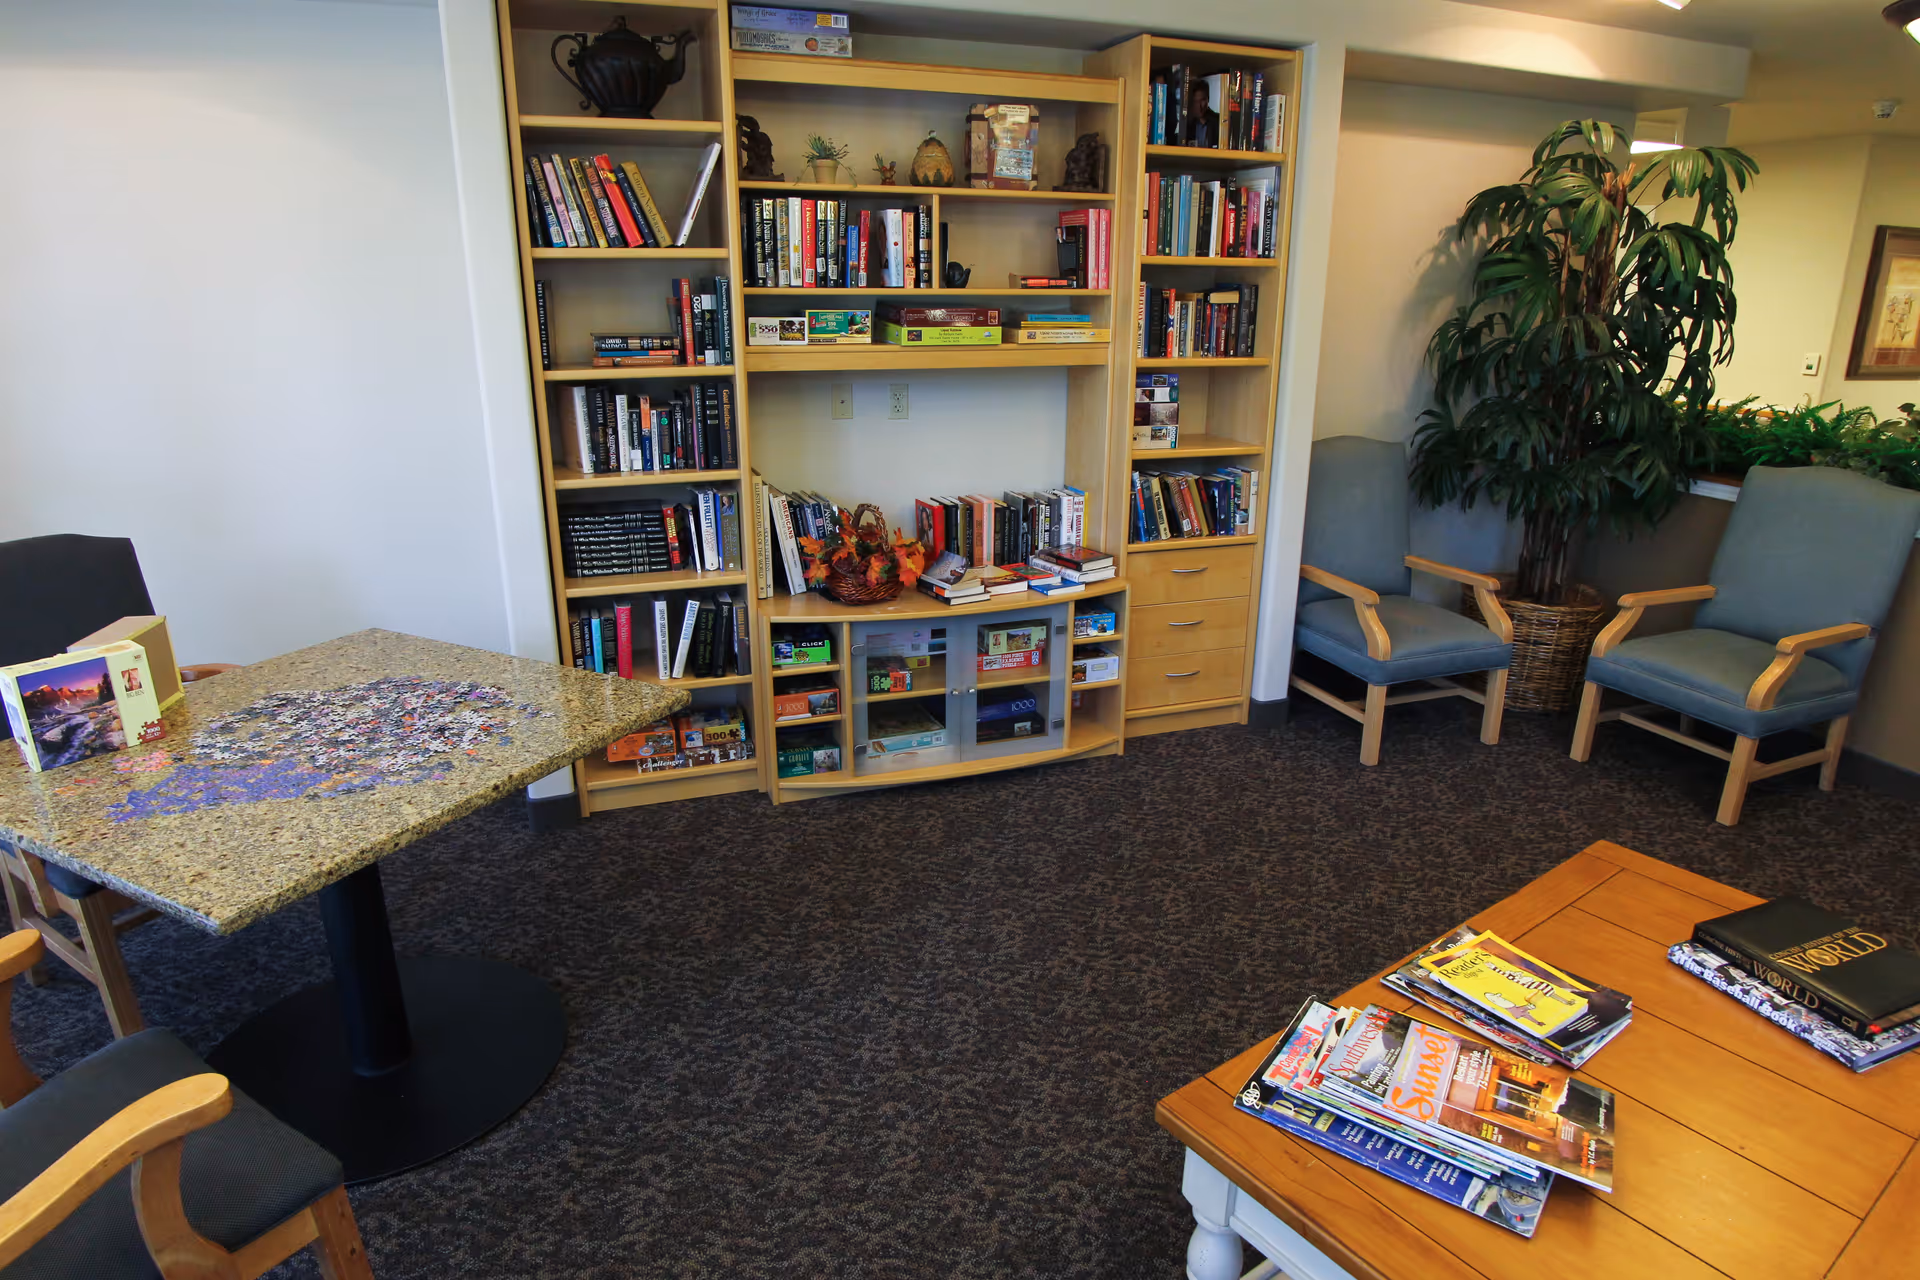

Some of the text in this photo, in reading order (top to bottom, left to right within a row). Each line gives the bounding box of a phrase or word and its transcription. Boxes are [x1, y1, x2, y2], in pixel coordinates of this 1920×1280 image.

[631, 169, 646, 198] Citizen
[1266, 207, 1272, 218] MY
[721, 282, 729, 310] Discovering
[722, 389, 731, 430] Goat Brothers
[754, 482, 762, 520] ILLUSTRATED
[704, 505, 713, 528] FOLLETT
[780, 499, 795, 540] AMERICANS
[685, 602, 697, 622] SANDRA
[126, 689, 145, 699] BIG BEN
[1011, 699, 1036, 711] 1000
[705, 731, 727, 742] 300
[642, 759, 684, 769] Challenger
[1768, 926, 1862, 961] CONCISE HISTORY OF THE
[1777, 932, 1888, 974] WORLD
[1439, 950, 1493, 980] Reader's
[1463, 969, 1485, 980] digest
[1677, 950, 1800, 1033] The Baseball Book
[1752, 960, 1820, 1009] WORLD
[1361, 1062, 1391, 1089] Painting
[1390, 1023, 1452, 1121] Sunset
[1452, 1054, 1469, 1082] Restart
[1465, 1050, 1482, 1086] your style
[1477, 1078, 1488, 1090] 73
